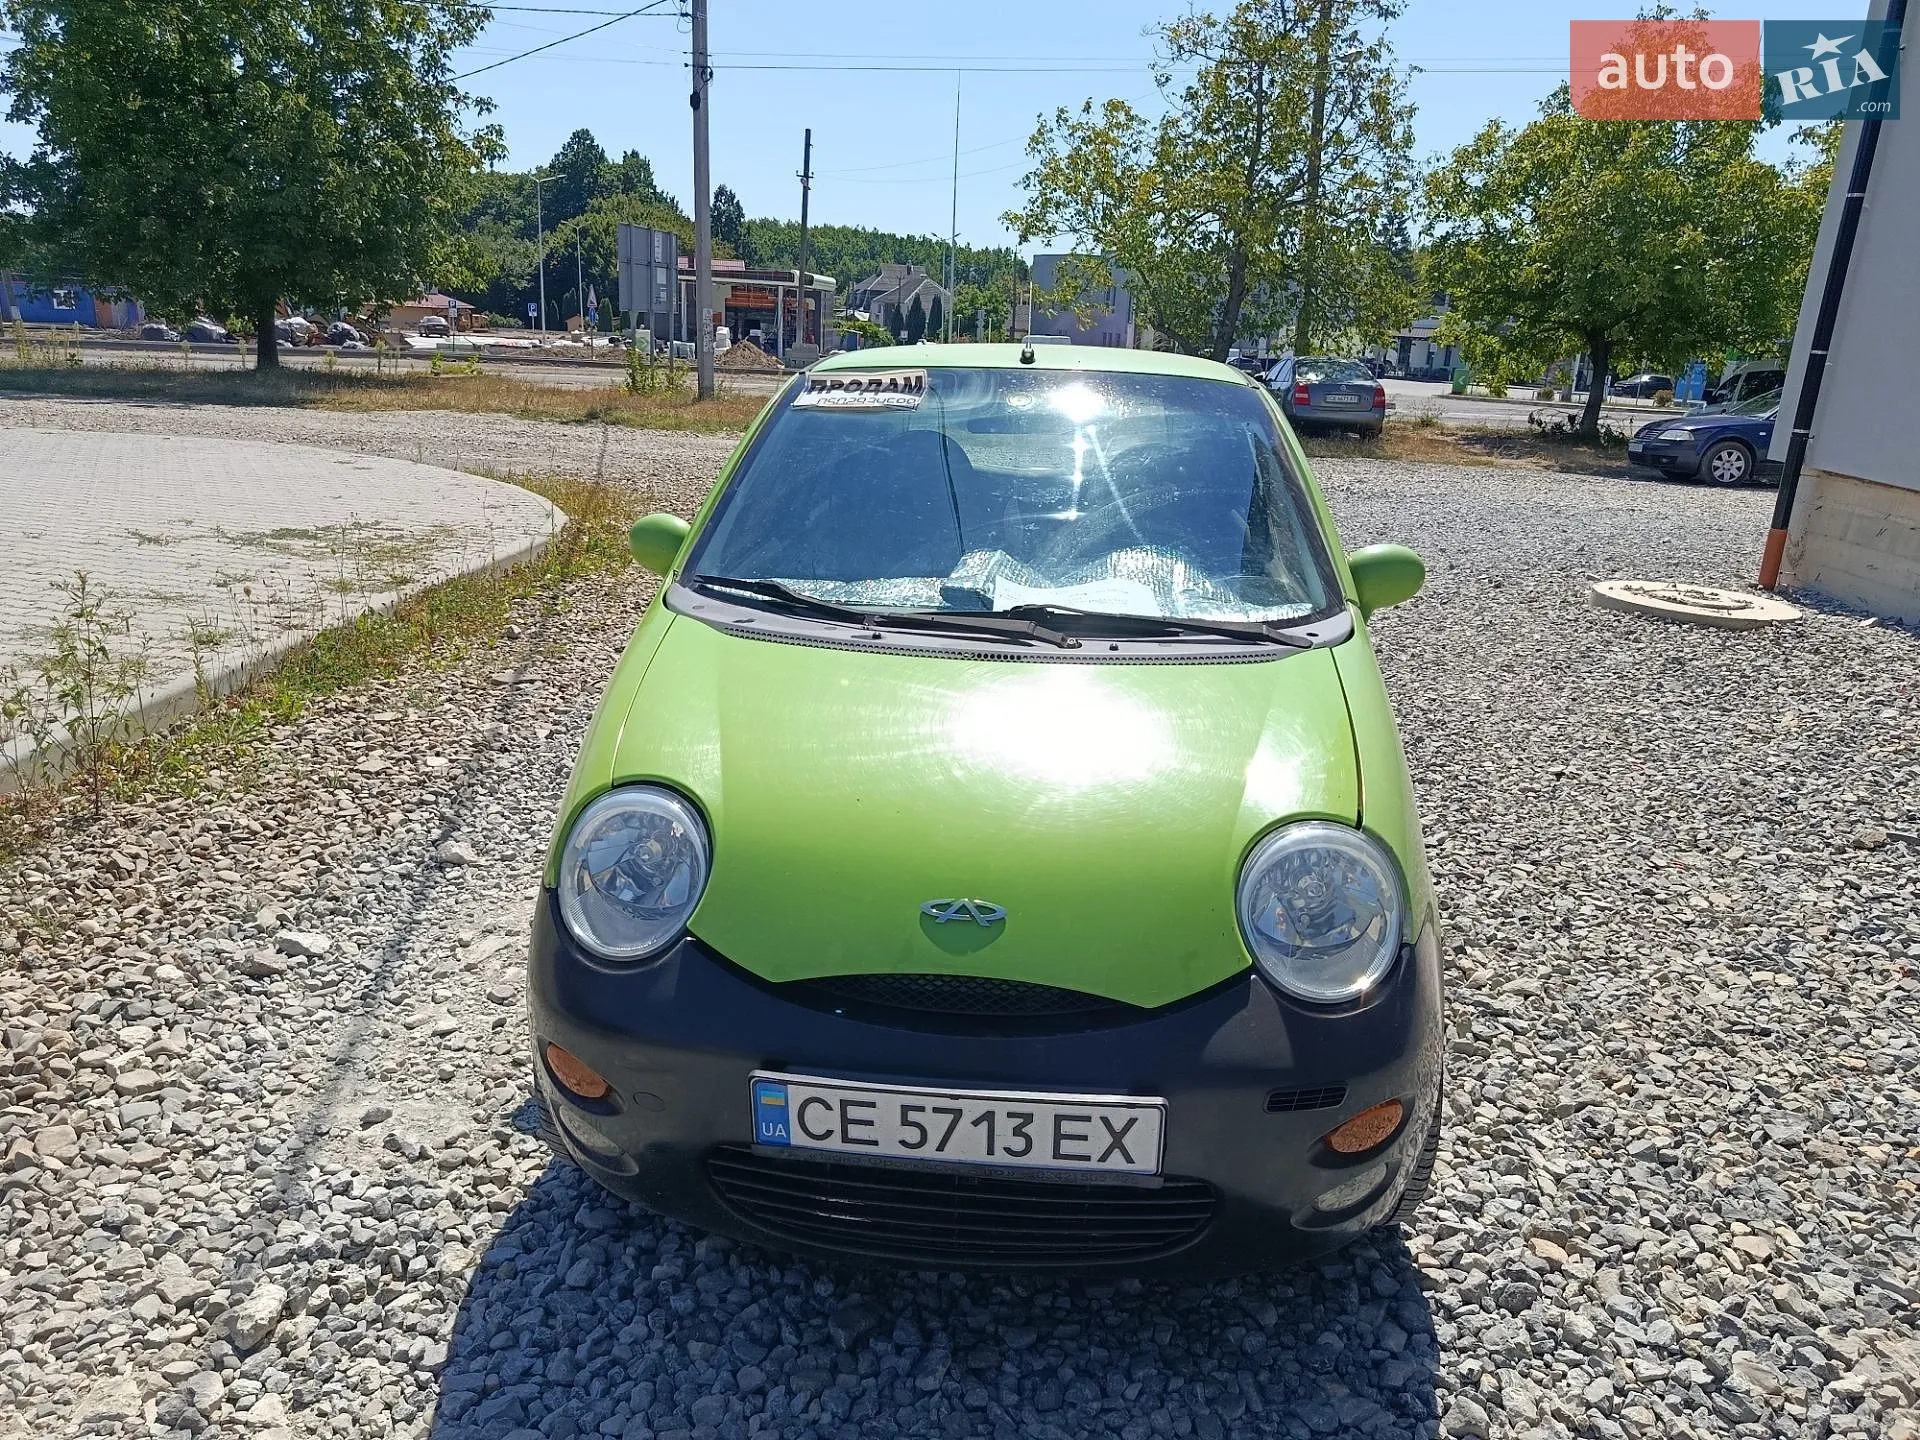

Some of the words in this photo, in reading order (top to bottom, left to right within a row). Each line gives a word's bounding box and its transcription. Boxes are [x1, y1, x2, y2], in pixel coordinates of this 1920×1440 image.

[808, 375, 923, 395] ПРОДАМ
[761, 1122, 787, 1138] UA
[797, 1096, 880, 1147] CE
[898, 1104, 1034, 1158] 5713
[1052, 1113, 1139, 1165] EX
